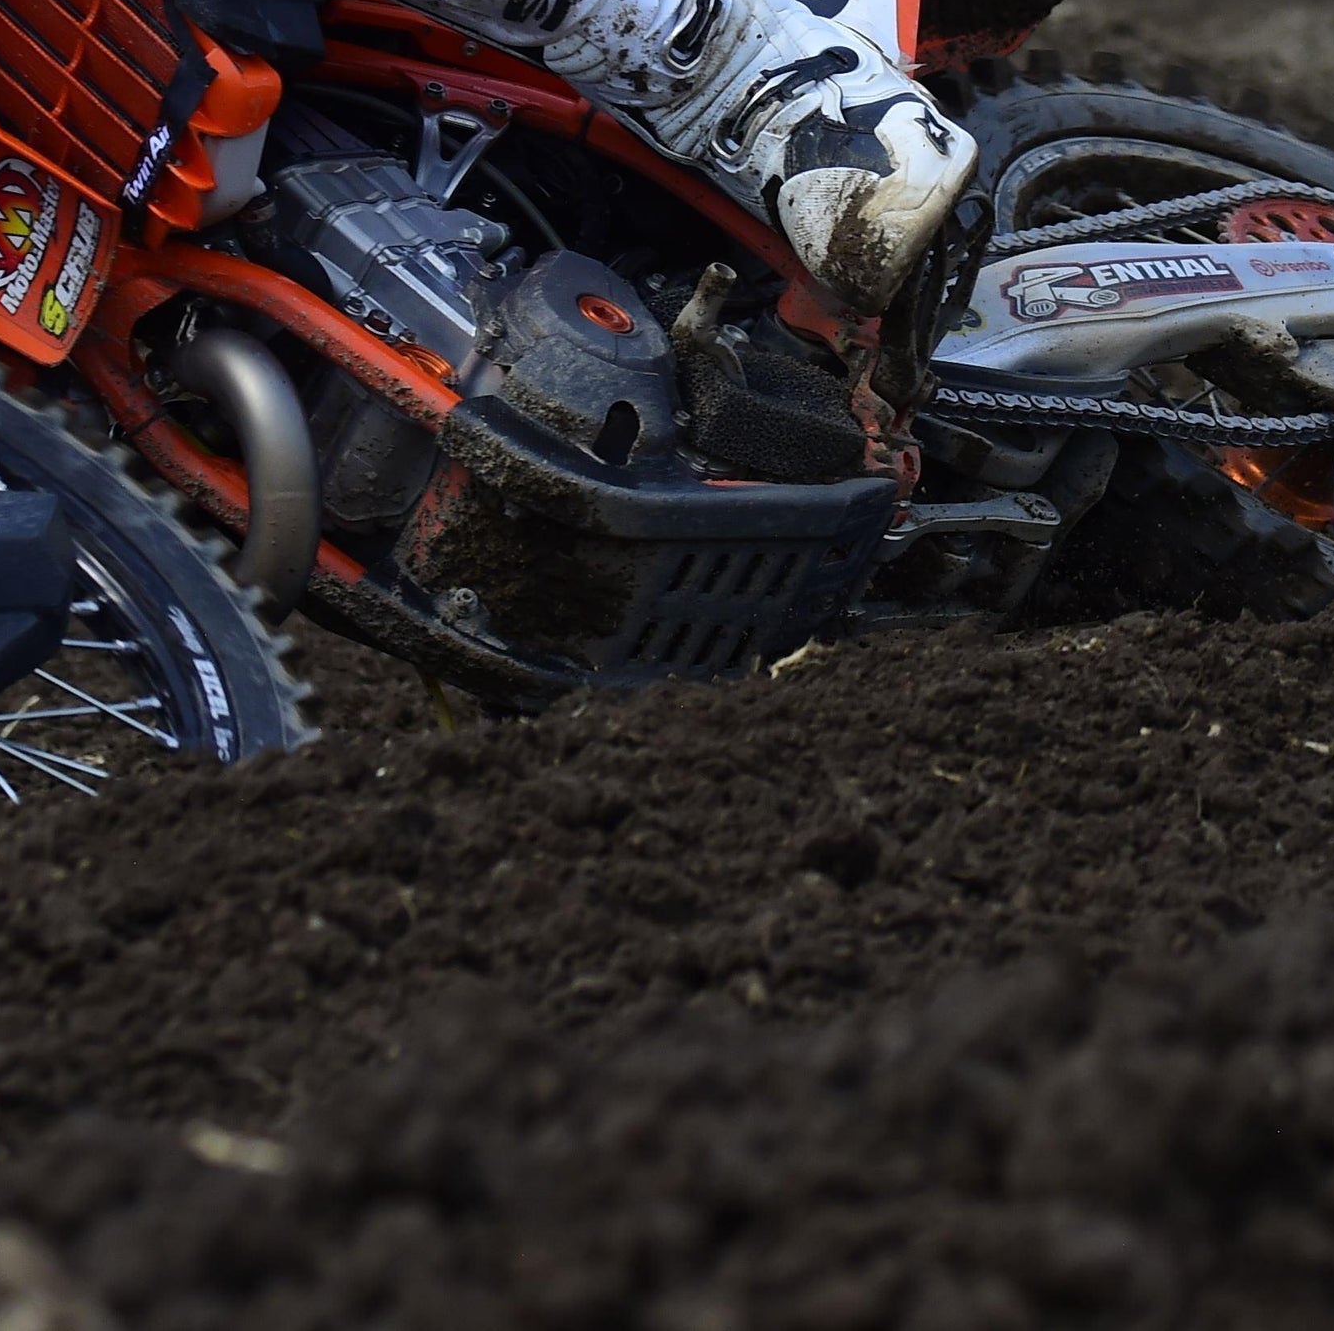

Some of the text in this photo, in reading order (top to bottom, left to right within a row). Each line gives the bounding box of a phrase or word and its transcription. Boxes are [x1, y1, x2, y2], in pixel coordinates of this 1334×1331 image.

[123, 125, 170, 205] Twin Air
[1008, 258, 1230, 319] RENTHAL
[1272, 260, 1331, 273] brembo
